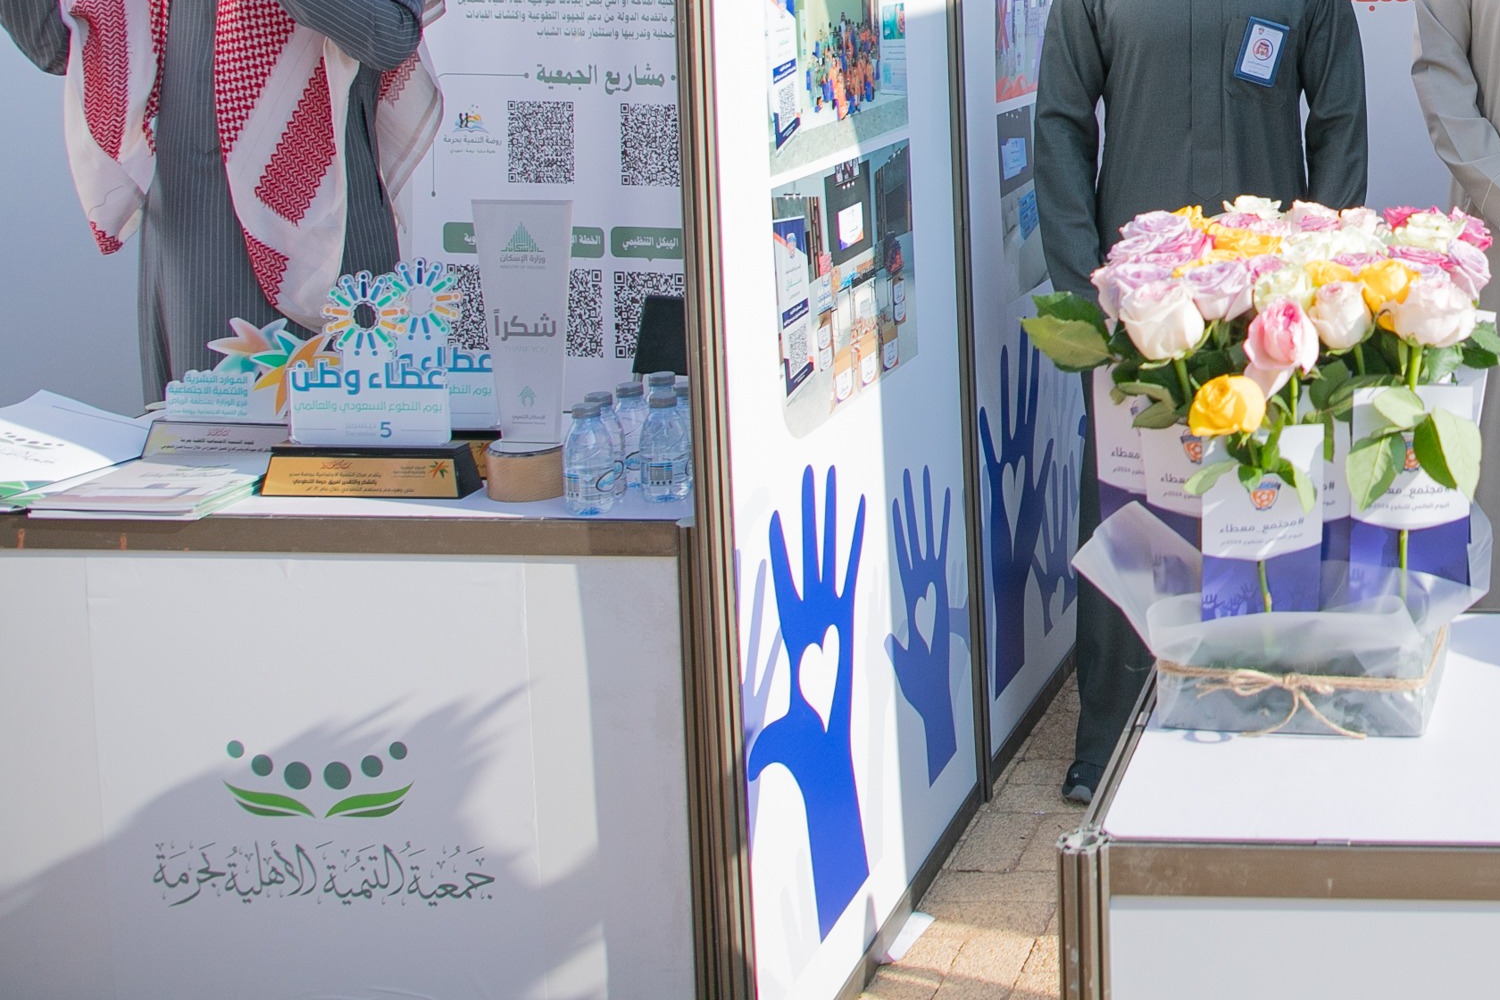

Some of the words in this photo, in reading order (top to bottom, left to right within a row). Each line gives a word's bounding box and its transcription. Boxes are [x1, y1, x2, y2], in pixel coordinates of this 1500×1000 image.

[536, 64, 598, 90] الجمعية
[604, 63, 665, 95] مشاريع
[622, 236, 654, 251] التنظيمي
[655, 236, 679, 250] الهيكل
[529, 255, 546, 265] وزارة
[291, 361, 361, 395] وطن
[369, 361, 446, 389] عطاء
[472, 386, 492, 396] يوم
[294, 401, 337, 412] والعالمي
[339, 401, 386, 413] السعودي
[388, 402, 421, 413] التطوع
[422, 403, 442, 413] يوم
[379, 421, 392, 438] 5
